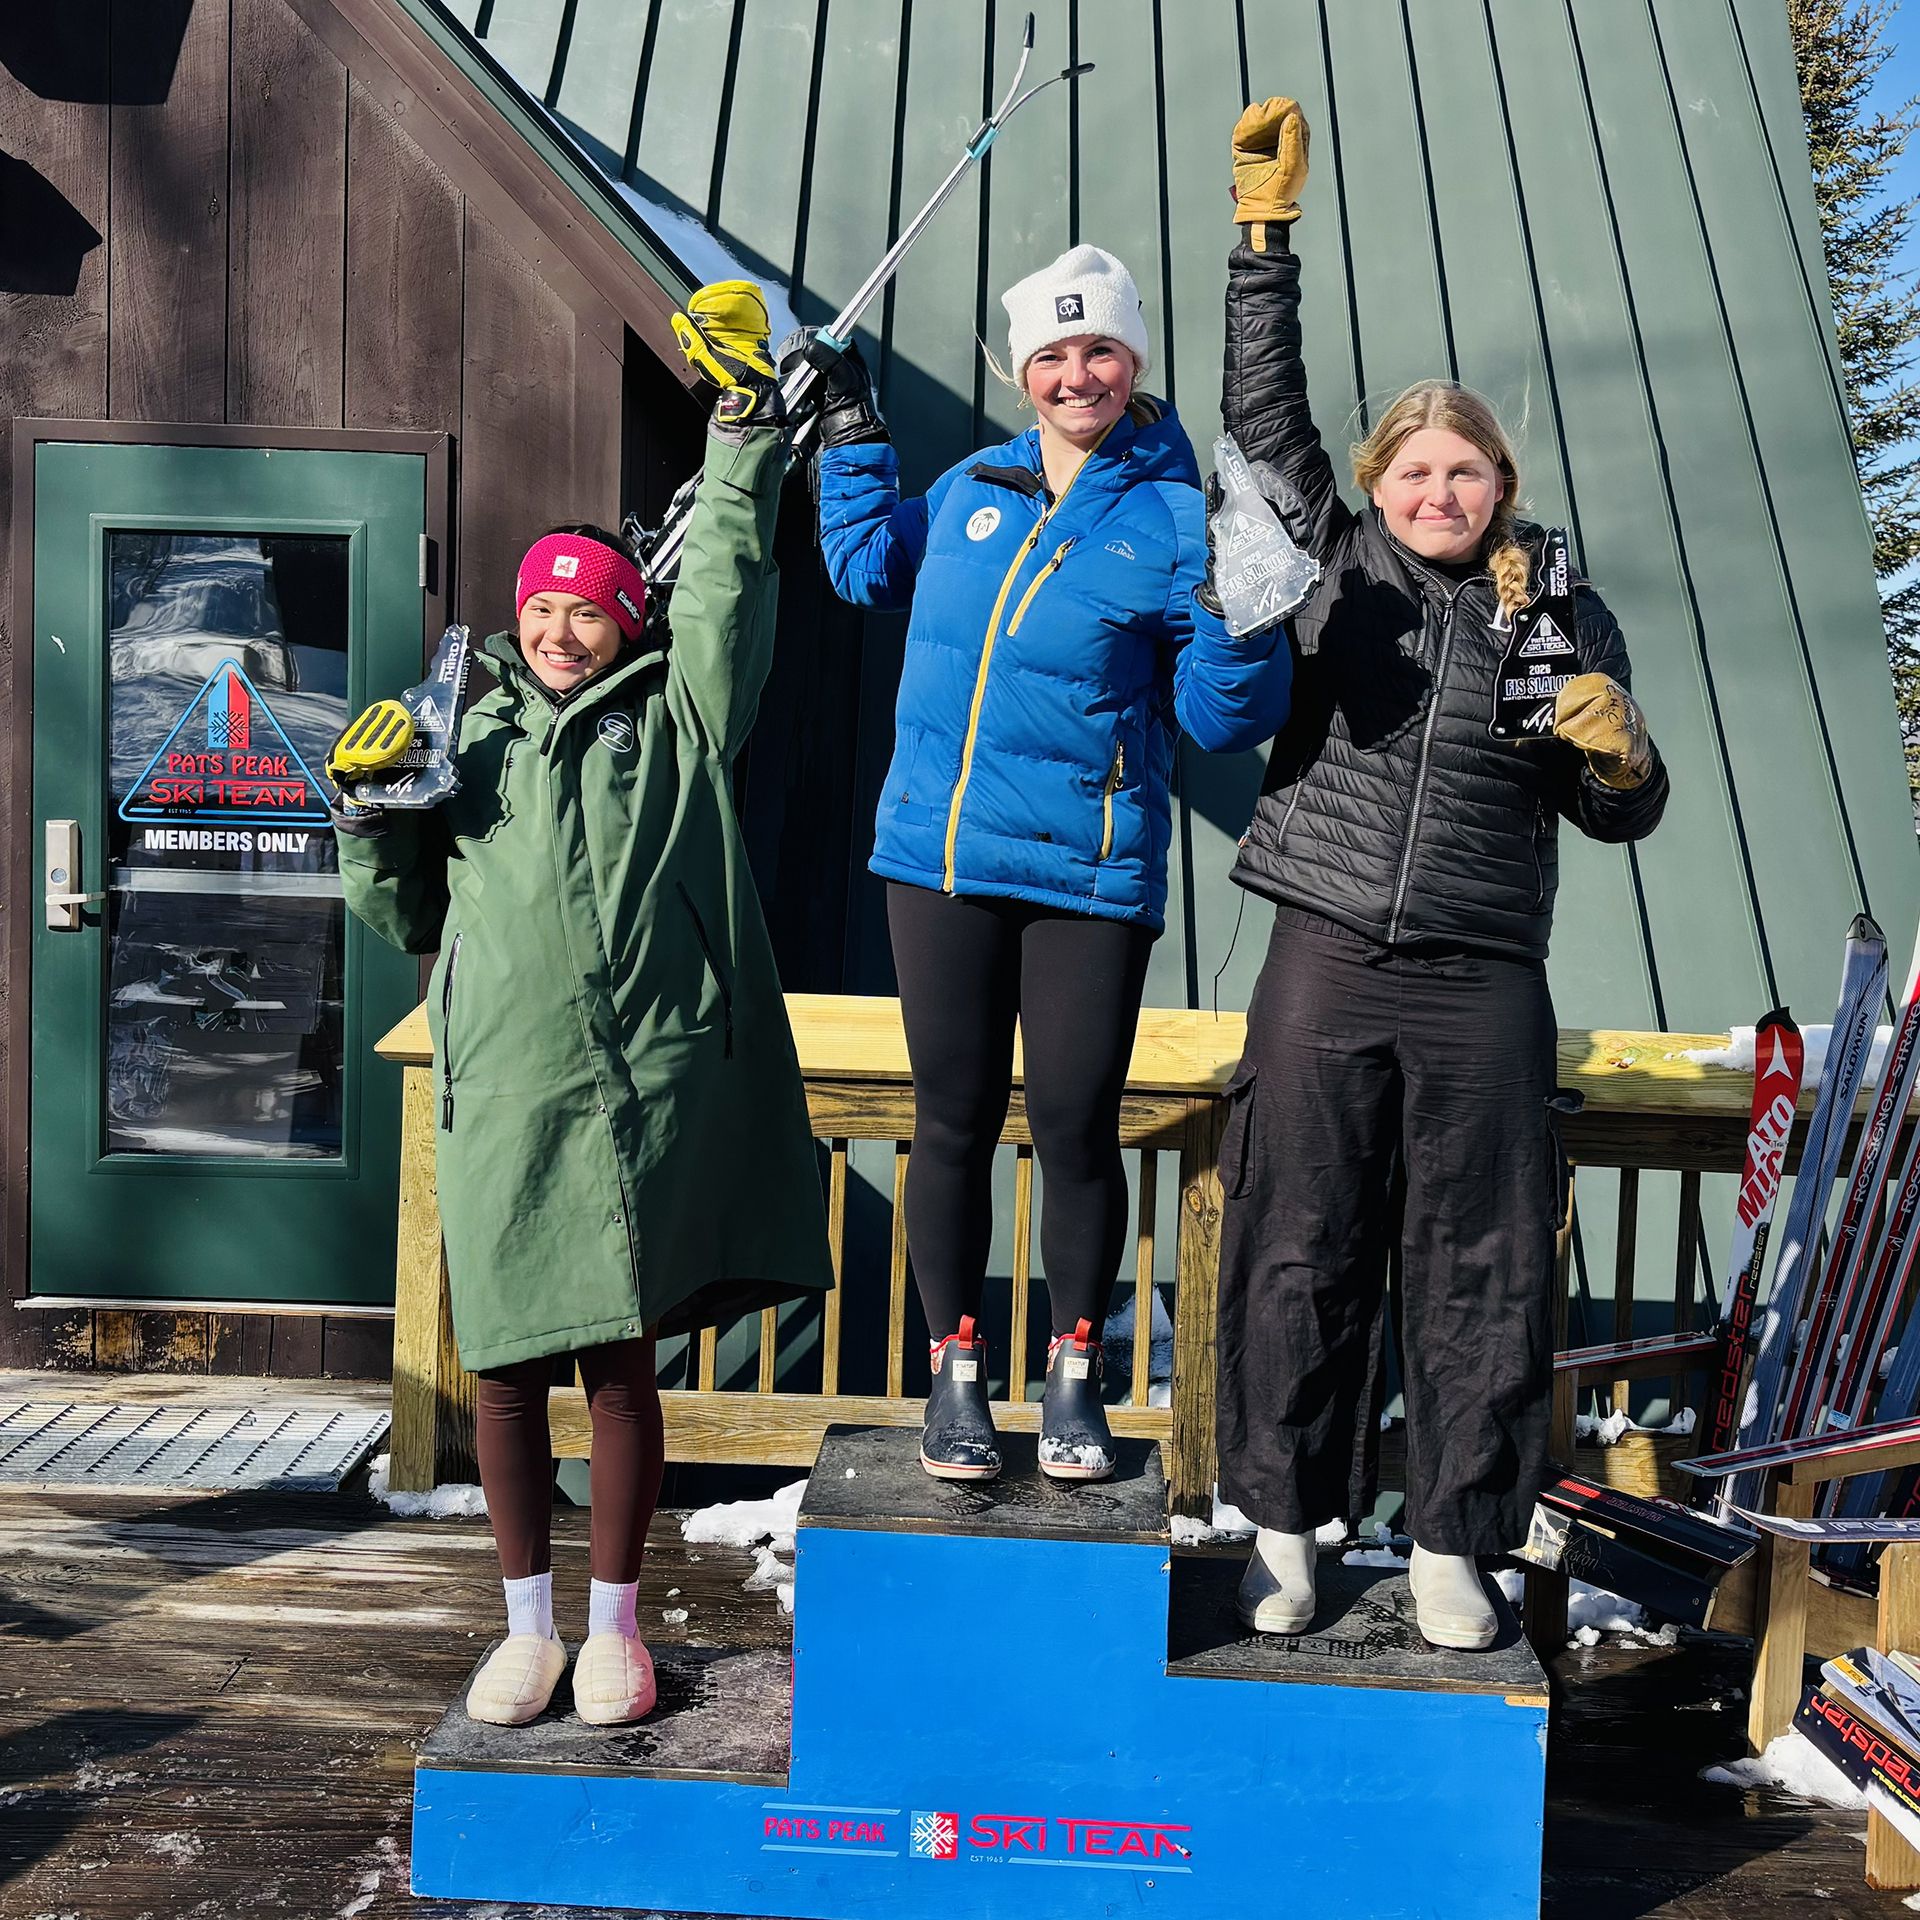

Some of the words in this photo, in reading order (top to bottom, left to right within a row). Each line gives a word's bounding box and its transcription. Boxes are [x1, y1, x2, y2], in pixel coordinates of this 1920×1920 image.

[1226, 455, 1251, 492] FIRST
[1555, 547, 1568, 597] SECOND
[443, 642, 460, 684] THIRD
[1529, 664, 1552, 675] 2026
[1505, 678, 1526, 696] FIS
[1527, 674, 1576, 695] SLALO
[167, 753, 224, 775] PATS
[232, 755, 288, 776] PEAK
[149, 779, 204, 804] SKI
[211, 780, 305, 807] TEAM
[144, 829, 253, 852] MEMBERS
[257, 833, 310, 853] ONLY
[1840, 1011, 1868, 1100] SALOMON
[1854, 1083, 1898, 1203] ROSSIGNOL
[1750, 1223, 1768, 1290] redster
[1712, 1273, 1751, 1452] redster
[1811, 1695, 1920, 1798] redster
[764, 1817, 820, 1840] PATS
[828, 1819, 886, 1842] PEAK
[967, 1814, 1047, 1851] SKI
[1057, 1816, 1192, 1860] TEAM
[970, 1855, 984, 1863] EST
